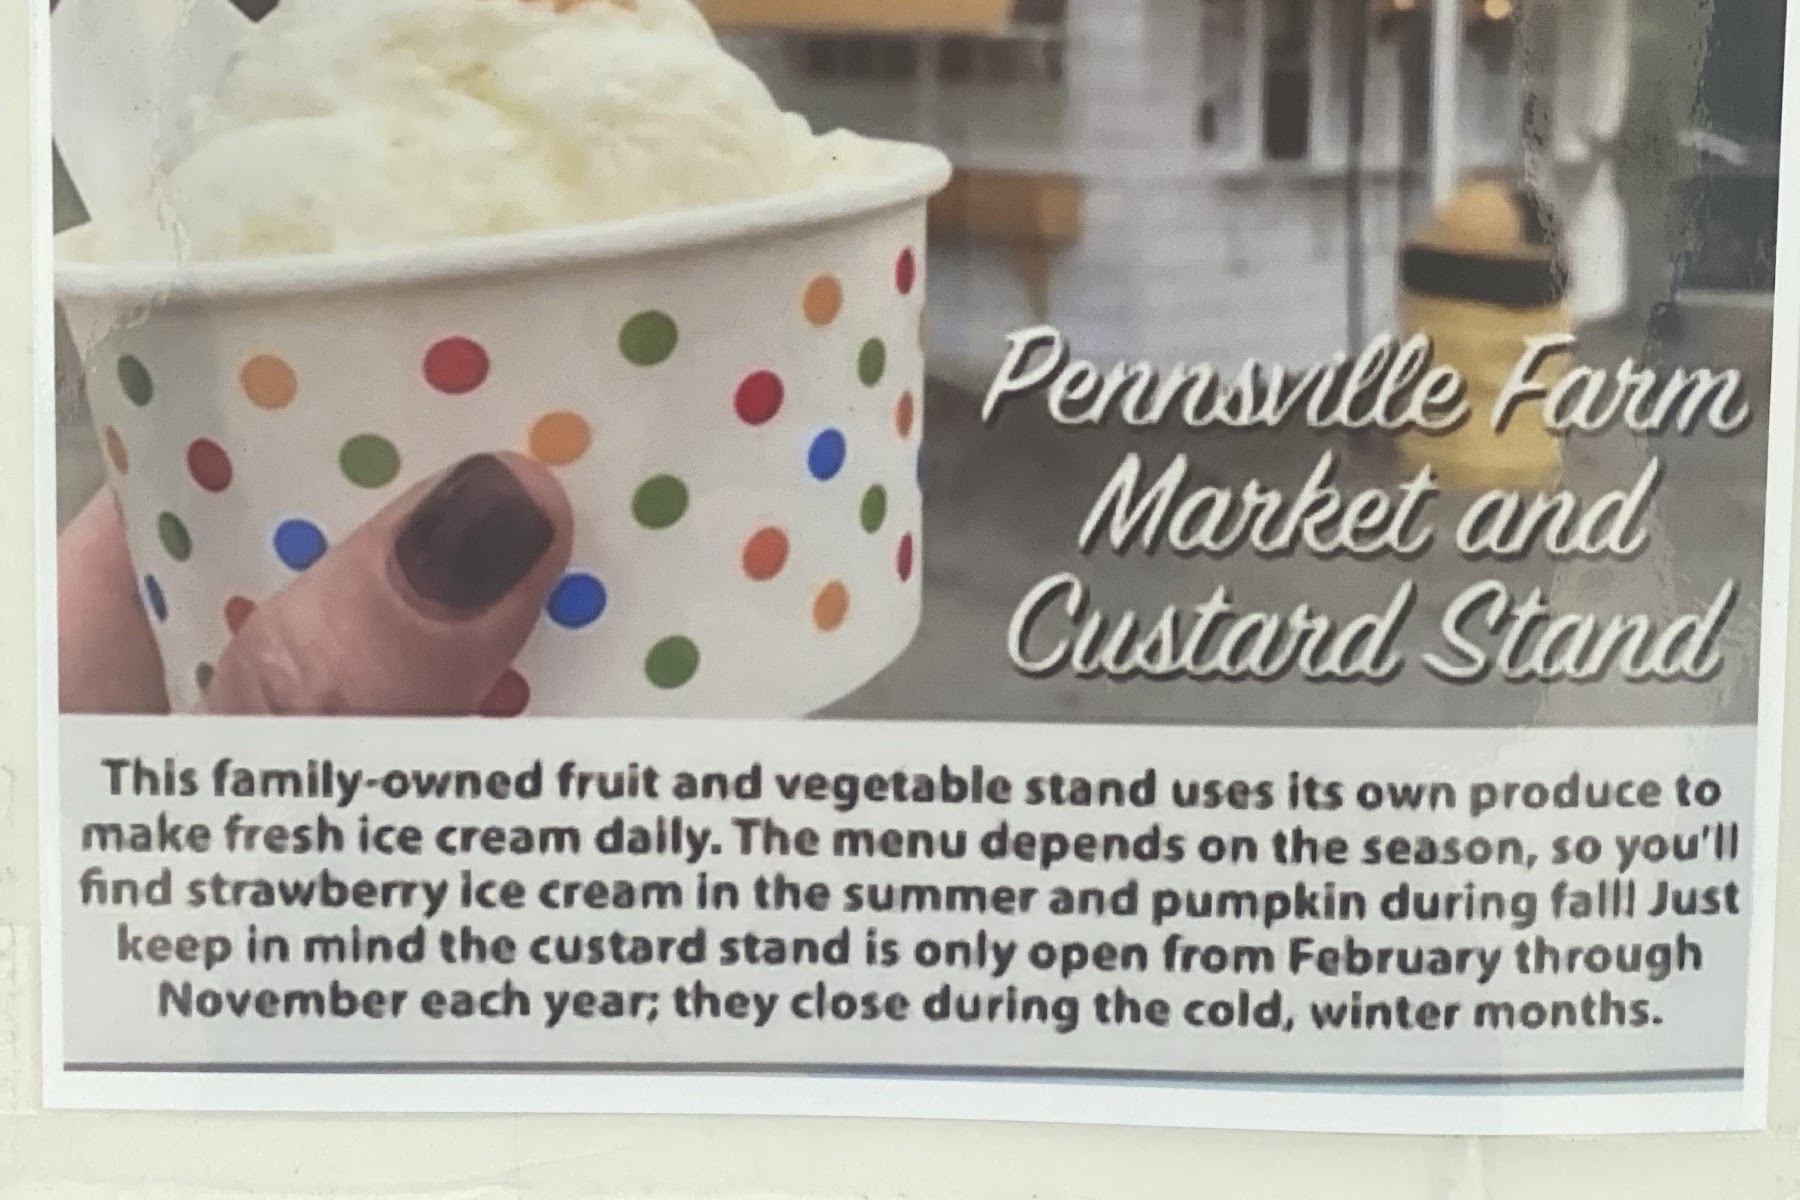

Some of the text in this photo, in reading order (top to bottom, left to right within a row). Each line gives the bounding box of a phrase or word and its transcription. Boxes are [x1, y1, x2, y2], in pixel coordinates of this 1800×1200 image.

[981, 324, 1751, 433] Pennsville Farm
[1077, 450, 1660, 556] Market and
[1006, 571, 1736, 681] Custard Stand
[101, 757, 1721, 817] This family-owned fruit and vegetable stand uses its own produce to
[83, 812, 1738, 873] make fresh ice cream daily. The menu depends on the season, so you'll
[80, 867, 171, 906] find
[188, 868, 448, 919] strawberry
[461, 870, 525, 908] ice
[539, 880, 682, 909] cream
[697, 872, 739, 910] in
[754, 873, 831, 911] the
[844, 883, 1038, 915] summer
[1049, 879, 1138, 916] and
[1152, 881, 1366, 929] pumpkin
[1380, 882, 1537, 929] during
[1648, 881, 1739, 916] Just
[118, 923, 1702, 984] keep in mind the custard stand is only open from February through
[160, 979, 1662, 1034] November each year; they close during the cold, winter months.
